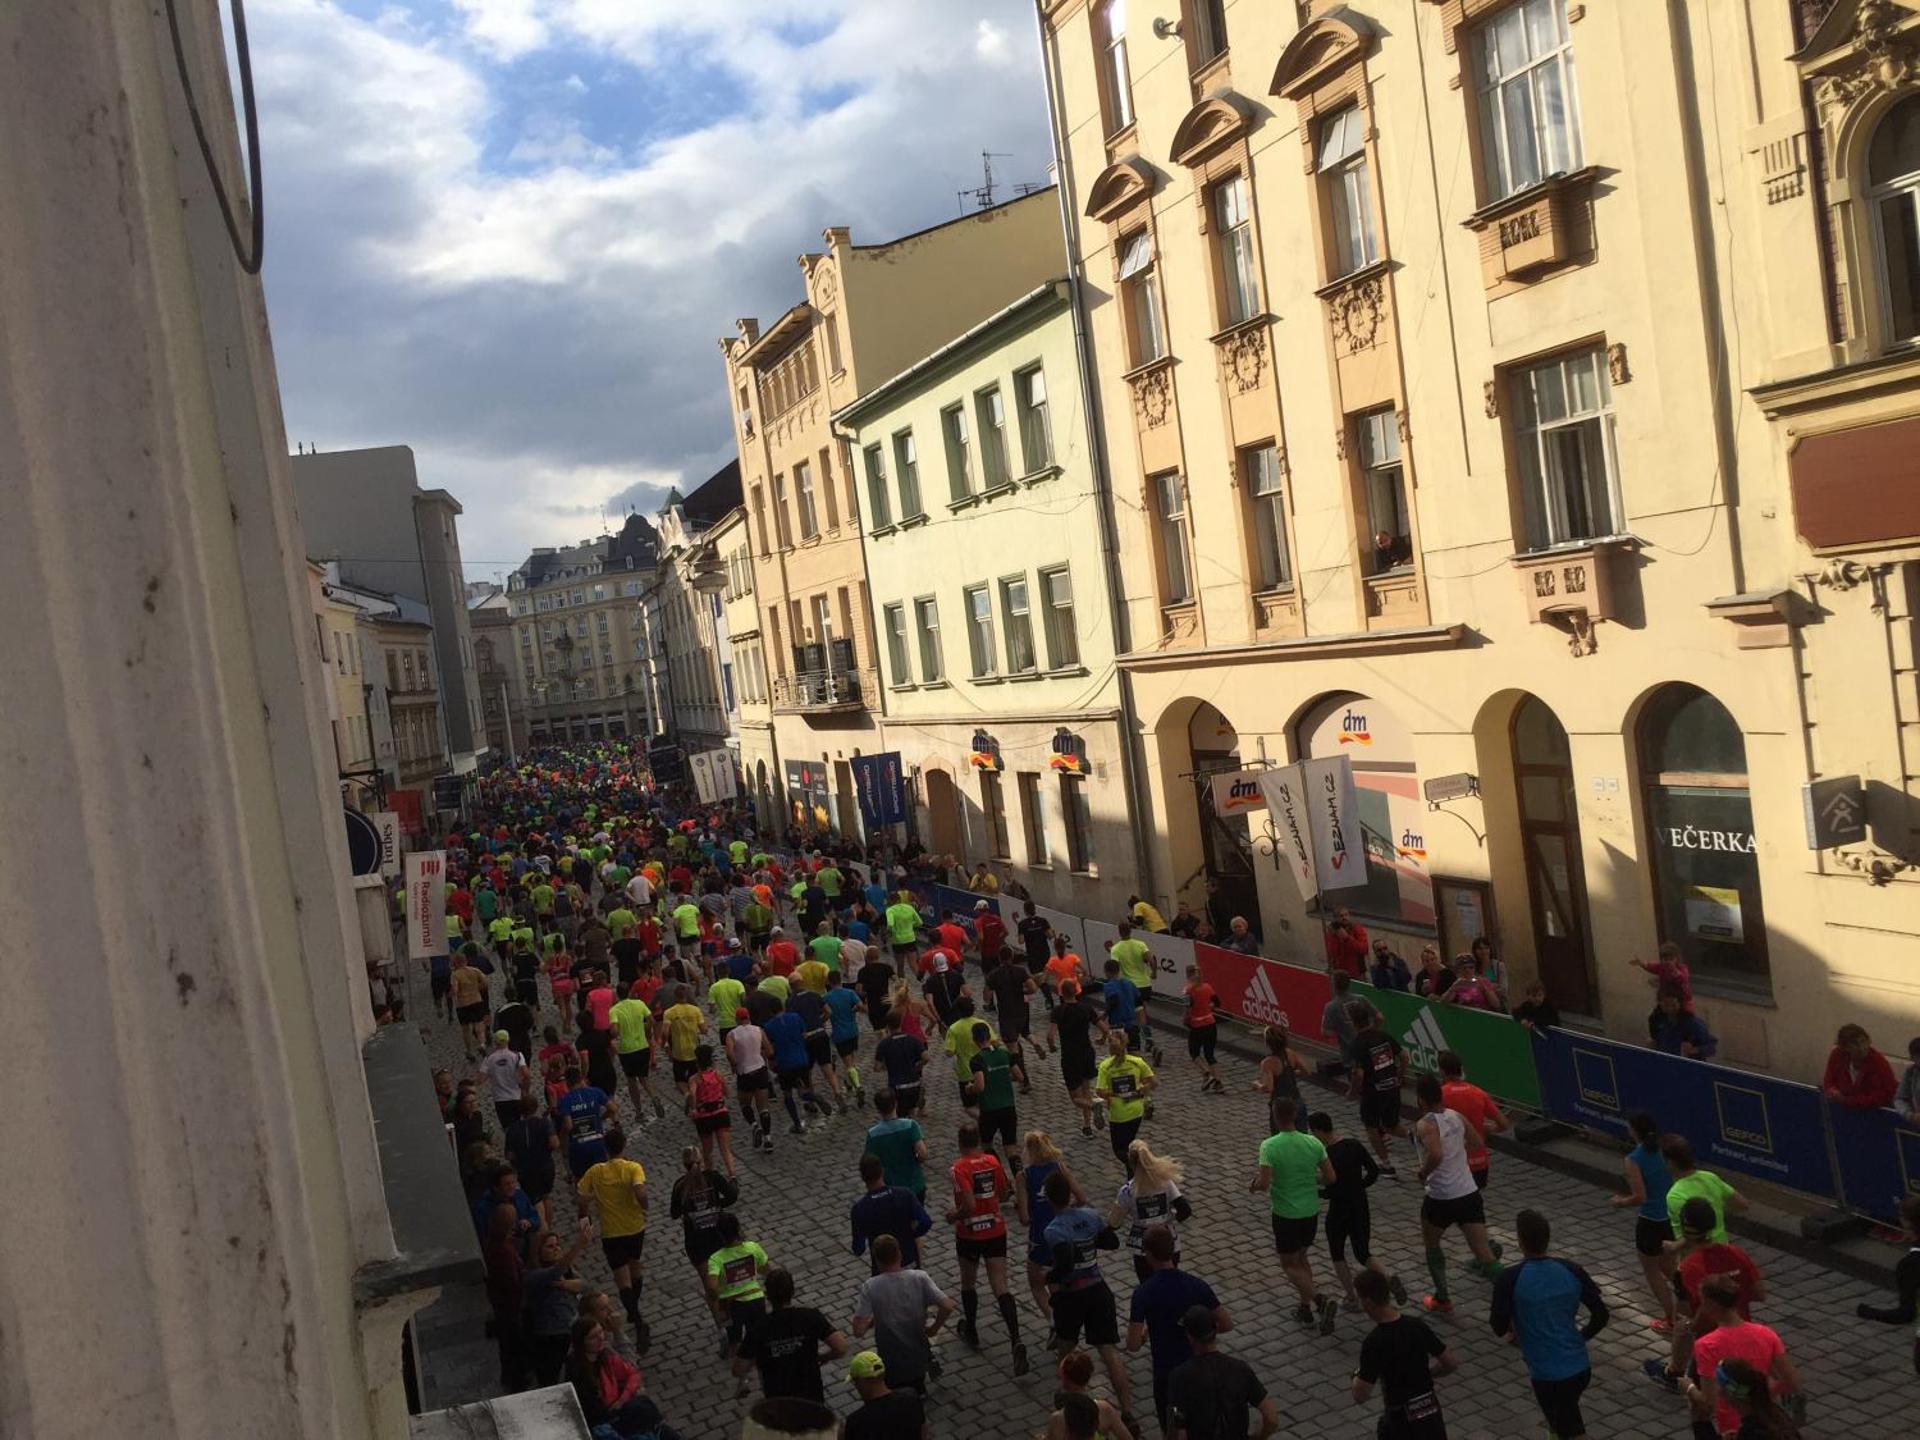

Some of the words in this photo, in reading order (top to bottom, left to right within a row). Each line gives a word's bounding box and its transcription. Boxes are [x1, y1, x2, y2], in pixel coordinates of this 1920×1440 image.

[1343, 709, 1367, 732] dm
[1230, 778, 1258, 798] dm
[1402, 829, 1423, 848] dm
[1242, 999, 1289, 1028] adidas
